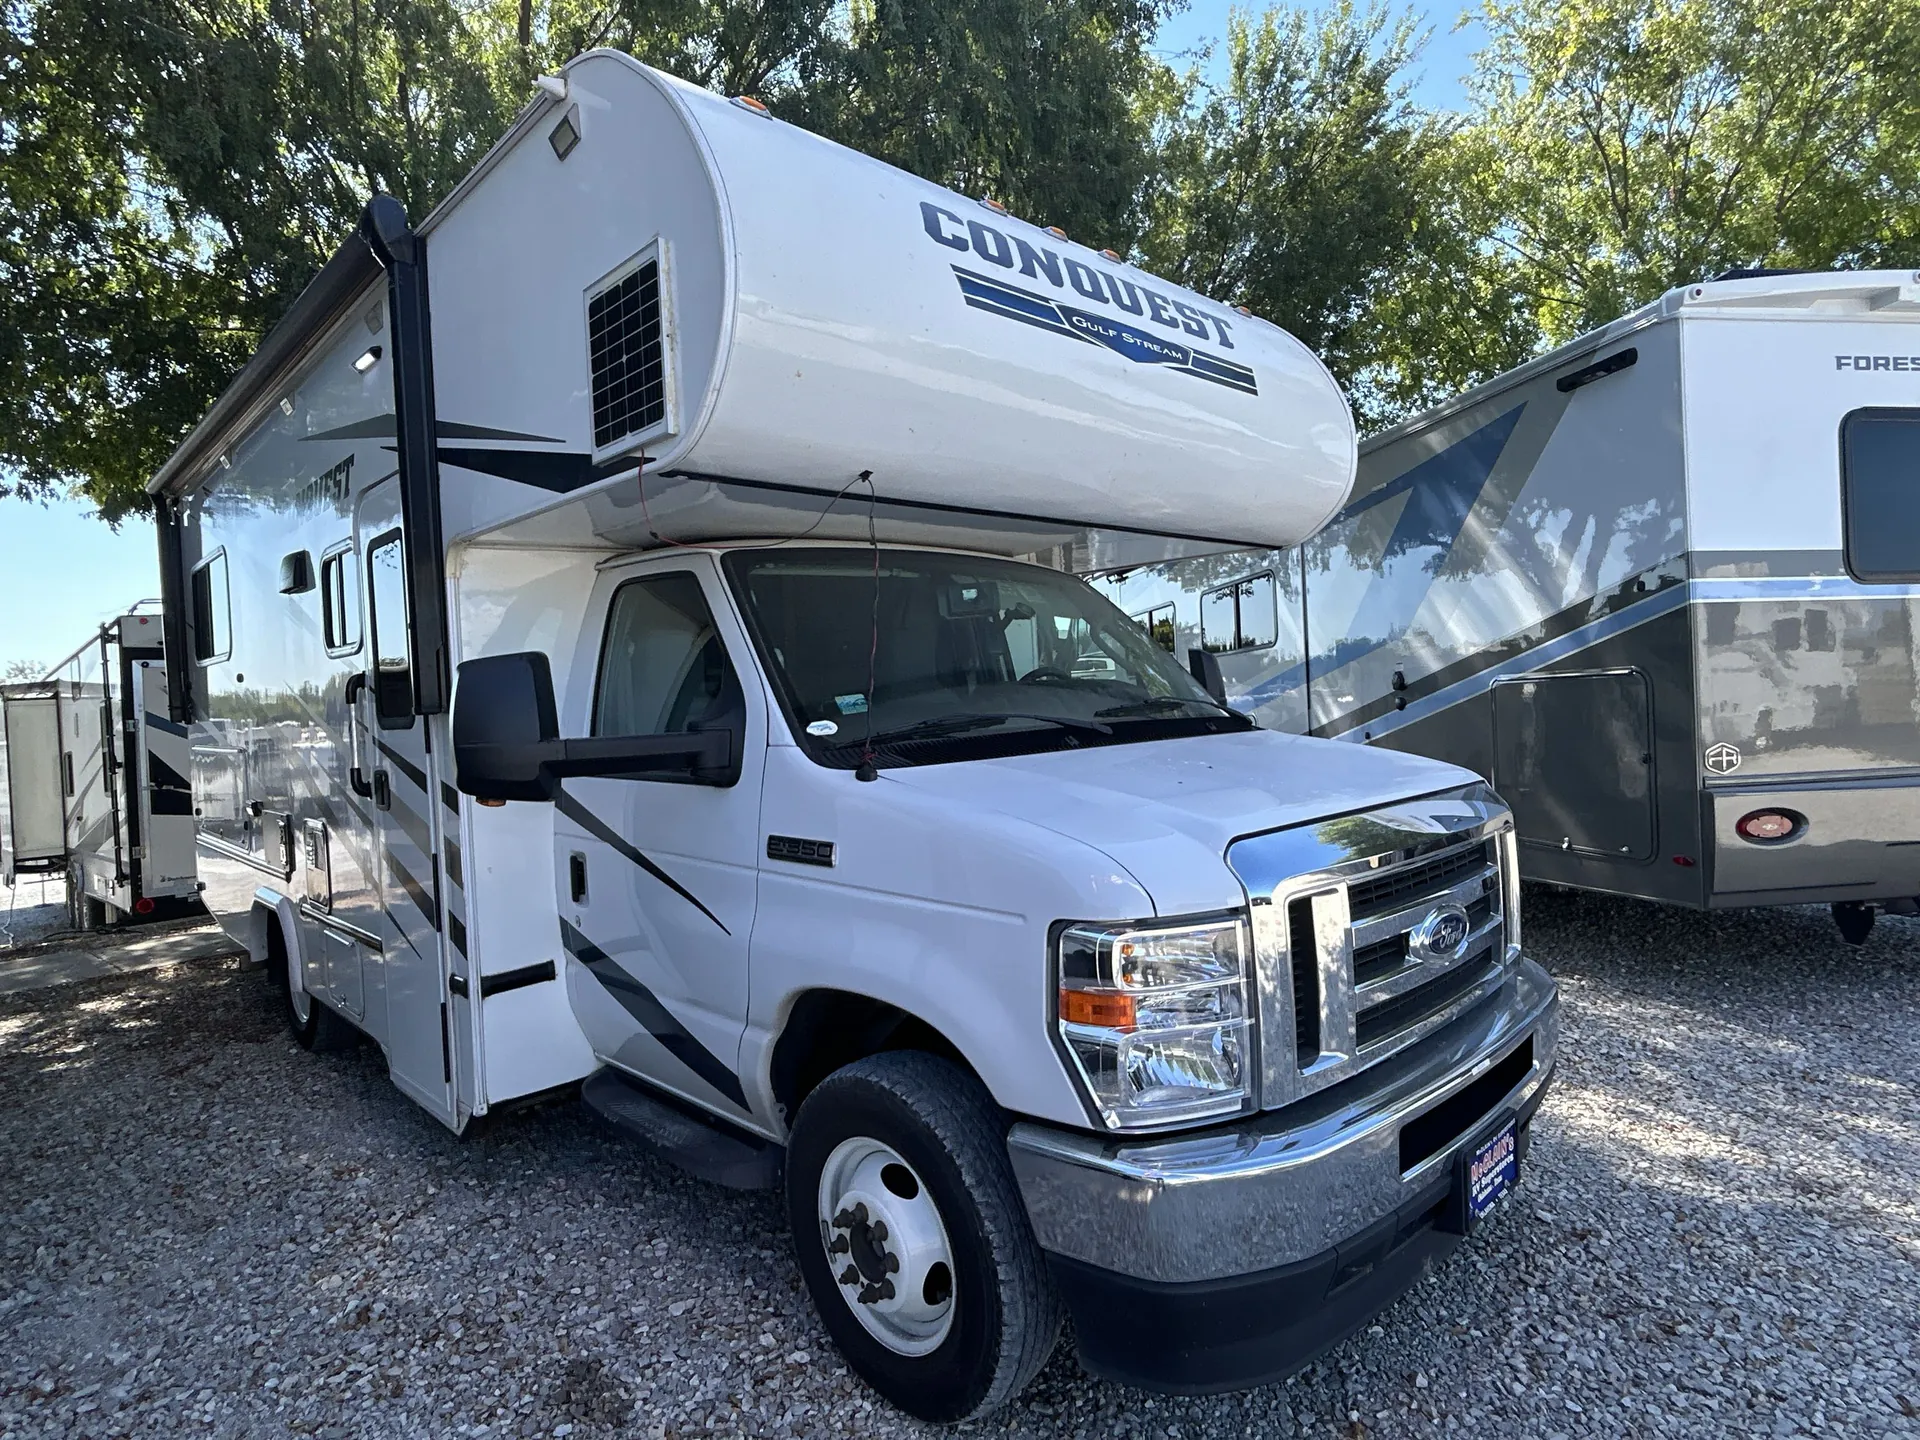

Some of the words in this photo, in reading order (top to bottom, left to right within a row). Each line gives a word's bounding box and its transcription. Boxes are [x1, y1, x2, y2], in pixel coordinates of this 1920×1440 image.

[919, 201, 1235, 349] CONQUEST
[1072, 316, 1117, 337] GULF
[1122, 333, 1183, 360] STREAM
[1440, 920, 1463, 949] Ford
